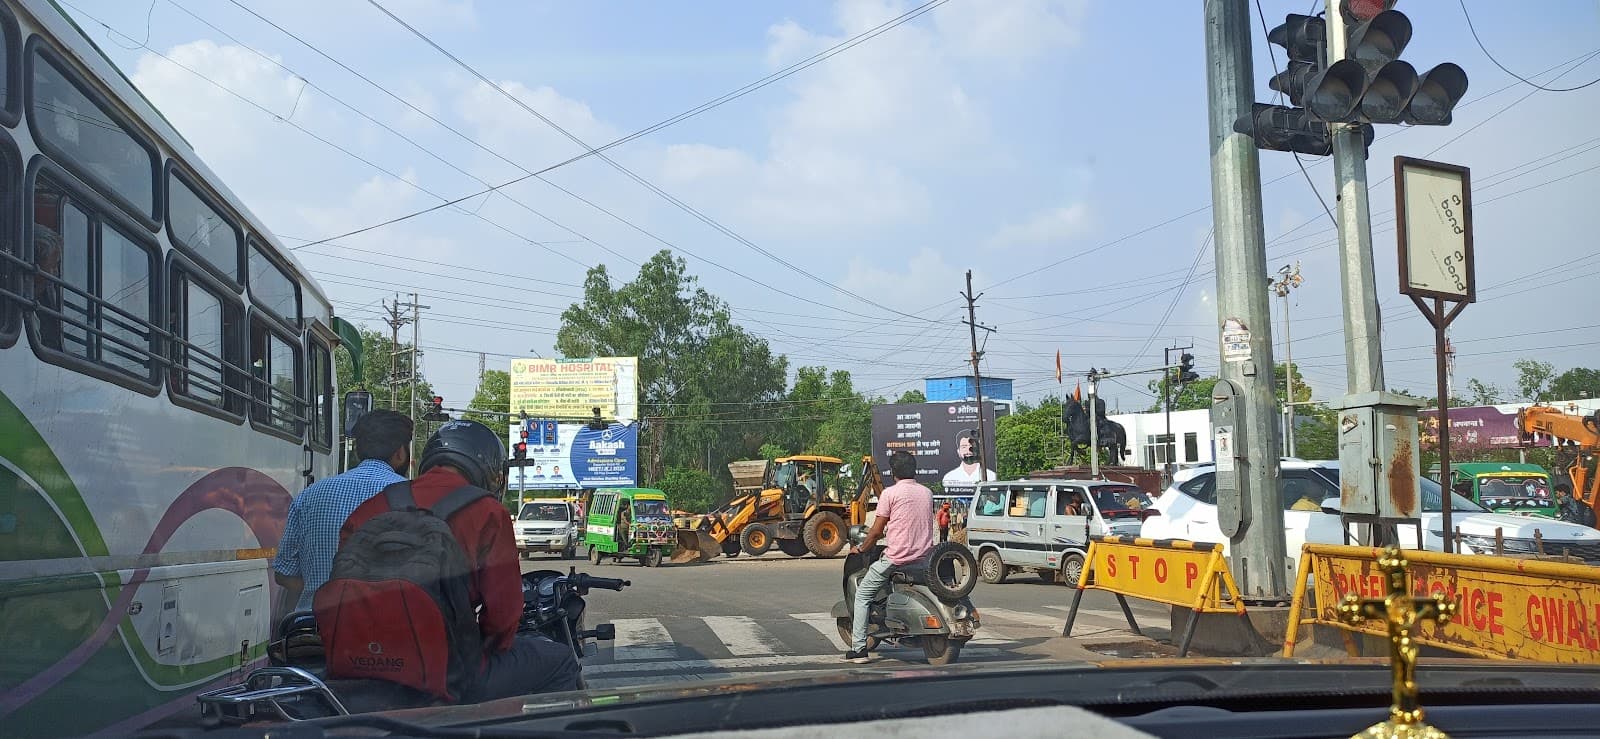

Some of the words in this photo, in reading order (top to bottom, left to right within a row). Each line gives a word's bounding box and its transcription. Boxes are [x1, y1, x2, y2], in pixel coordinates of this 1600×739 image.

[528, 363, 557, 373] BIMR
[589, 440, 625, 449] Aakash
[1107, 554, 1198, 589] STOP
[349, 656, 404, 667] VEDANG
